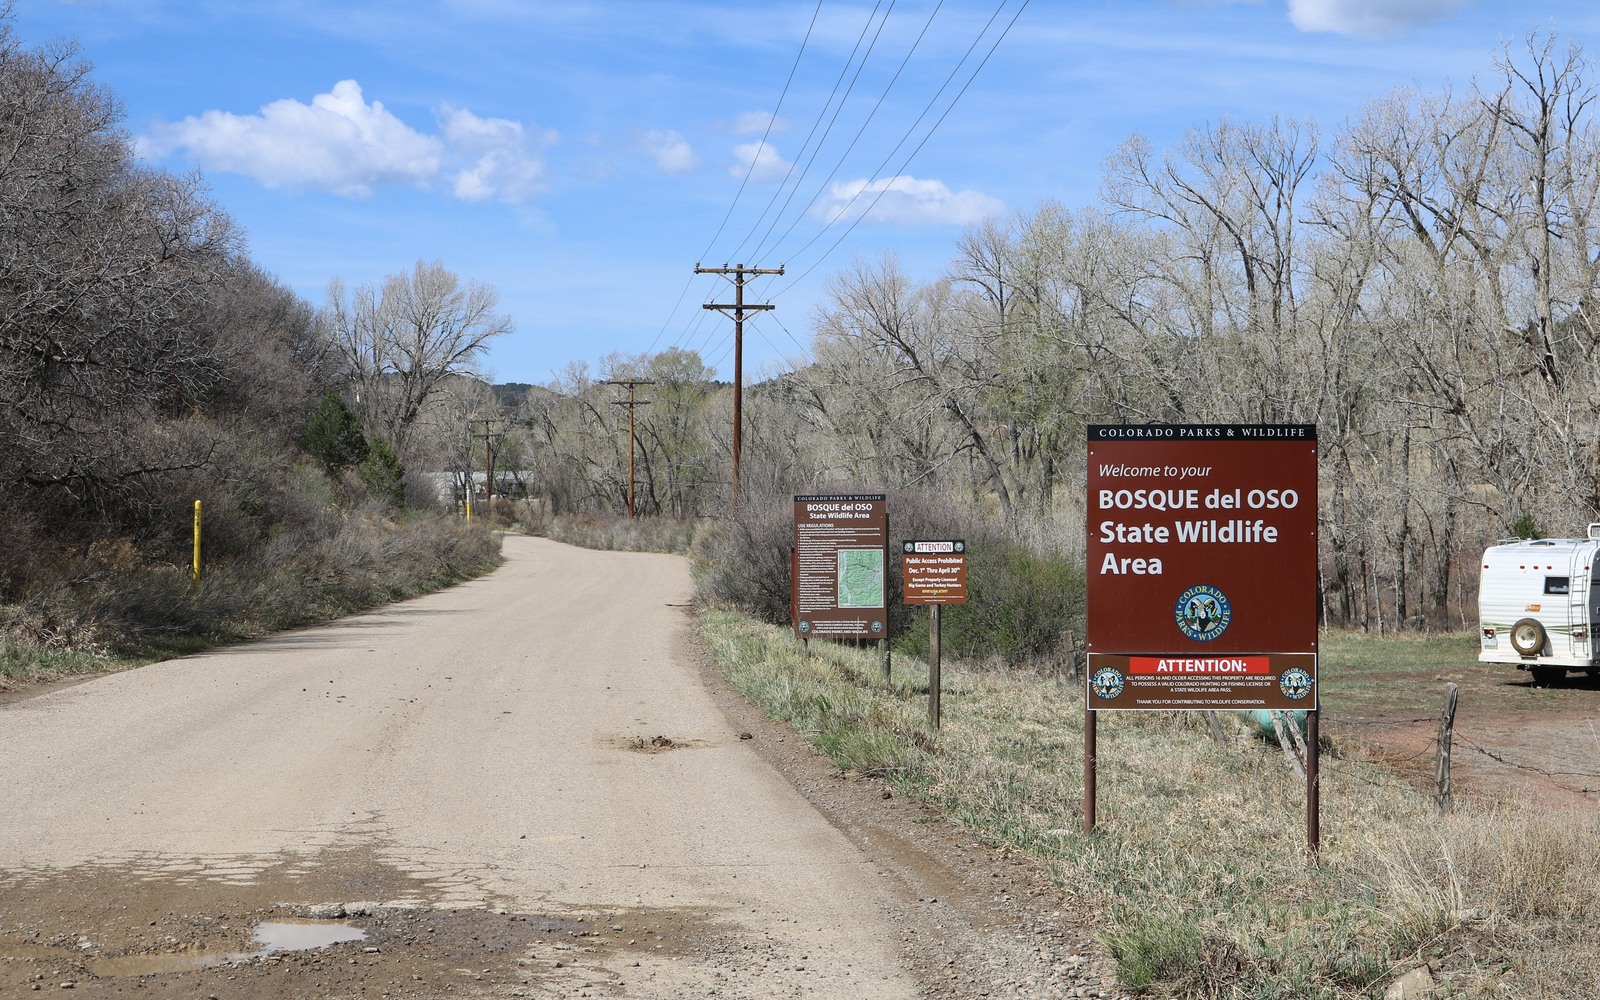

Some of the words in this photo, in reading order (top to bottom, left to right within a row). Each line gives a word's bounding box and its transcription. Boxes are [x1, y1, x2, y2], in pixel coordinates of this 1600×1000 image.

[1099, 428, 1174, 437] COLORADO
[1180, 428, 1221, 437] PARKS
[1226, 428, 1235, 437] &
[1242, 428, 1305, 437] WILDLIFE
[1099, 464, 1160, 477] Welcome
[1164, 465, 1178, 477] to
[1180, 466, 1212, 479] your
[807, 503, 840, 511] BOSQUE
[841, 503, 854, 511] del
[855, 503, 873, 511] OSO
[1099, 489, 1199, 512] BOSQUE
[1204, 488, 1241, 509] del
[1247, 489, 1299, 509] OSO
[1100, 520, 1170, 543] State
[1175, 519, 1278, 543] Wildlife
[917, 543, 952, 551] ATTENTION
[1100, 552, 1163, 575] Area
[1179, 585, 1227, 604] COLORADO
[1176, 610, 1193, 637] PARKS
[1198, 609, 1231, 640] WILDLIFE
[1094, 667, 1122, 678] COLORADO
[1157, 659, 1247, 672] ATTENTION:
[1282, 667, 1310, 679] COLORADO
